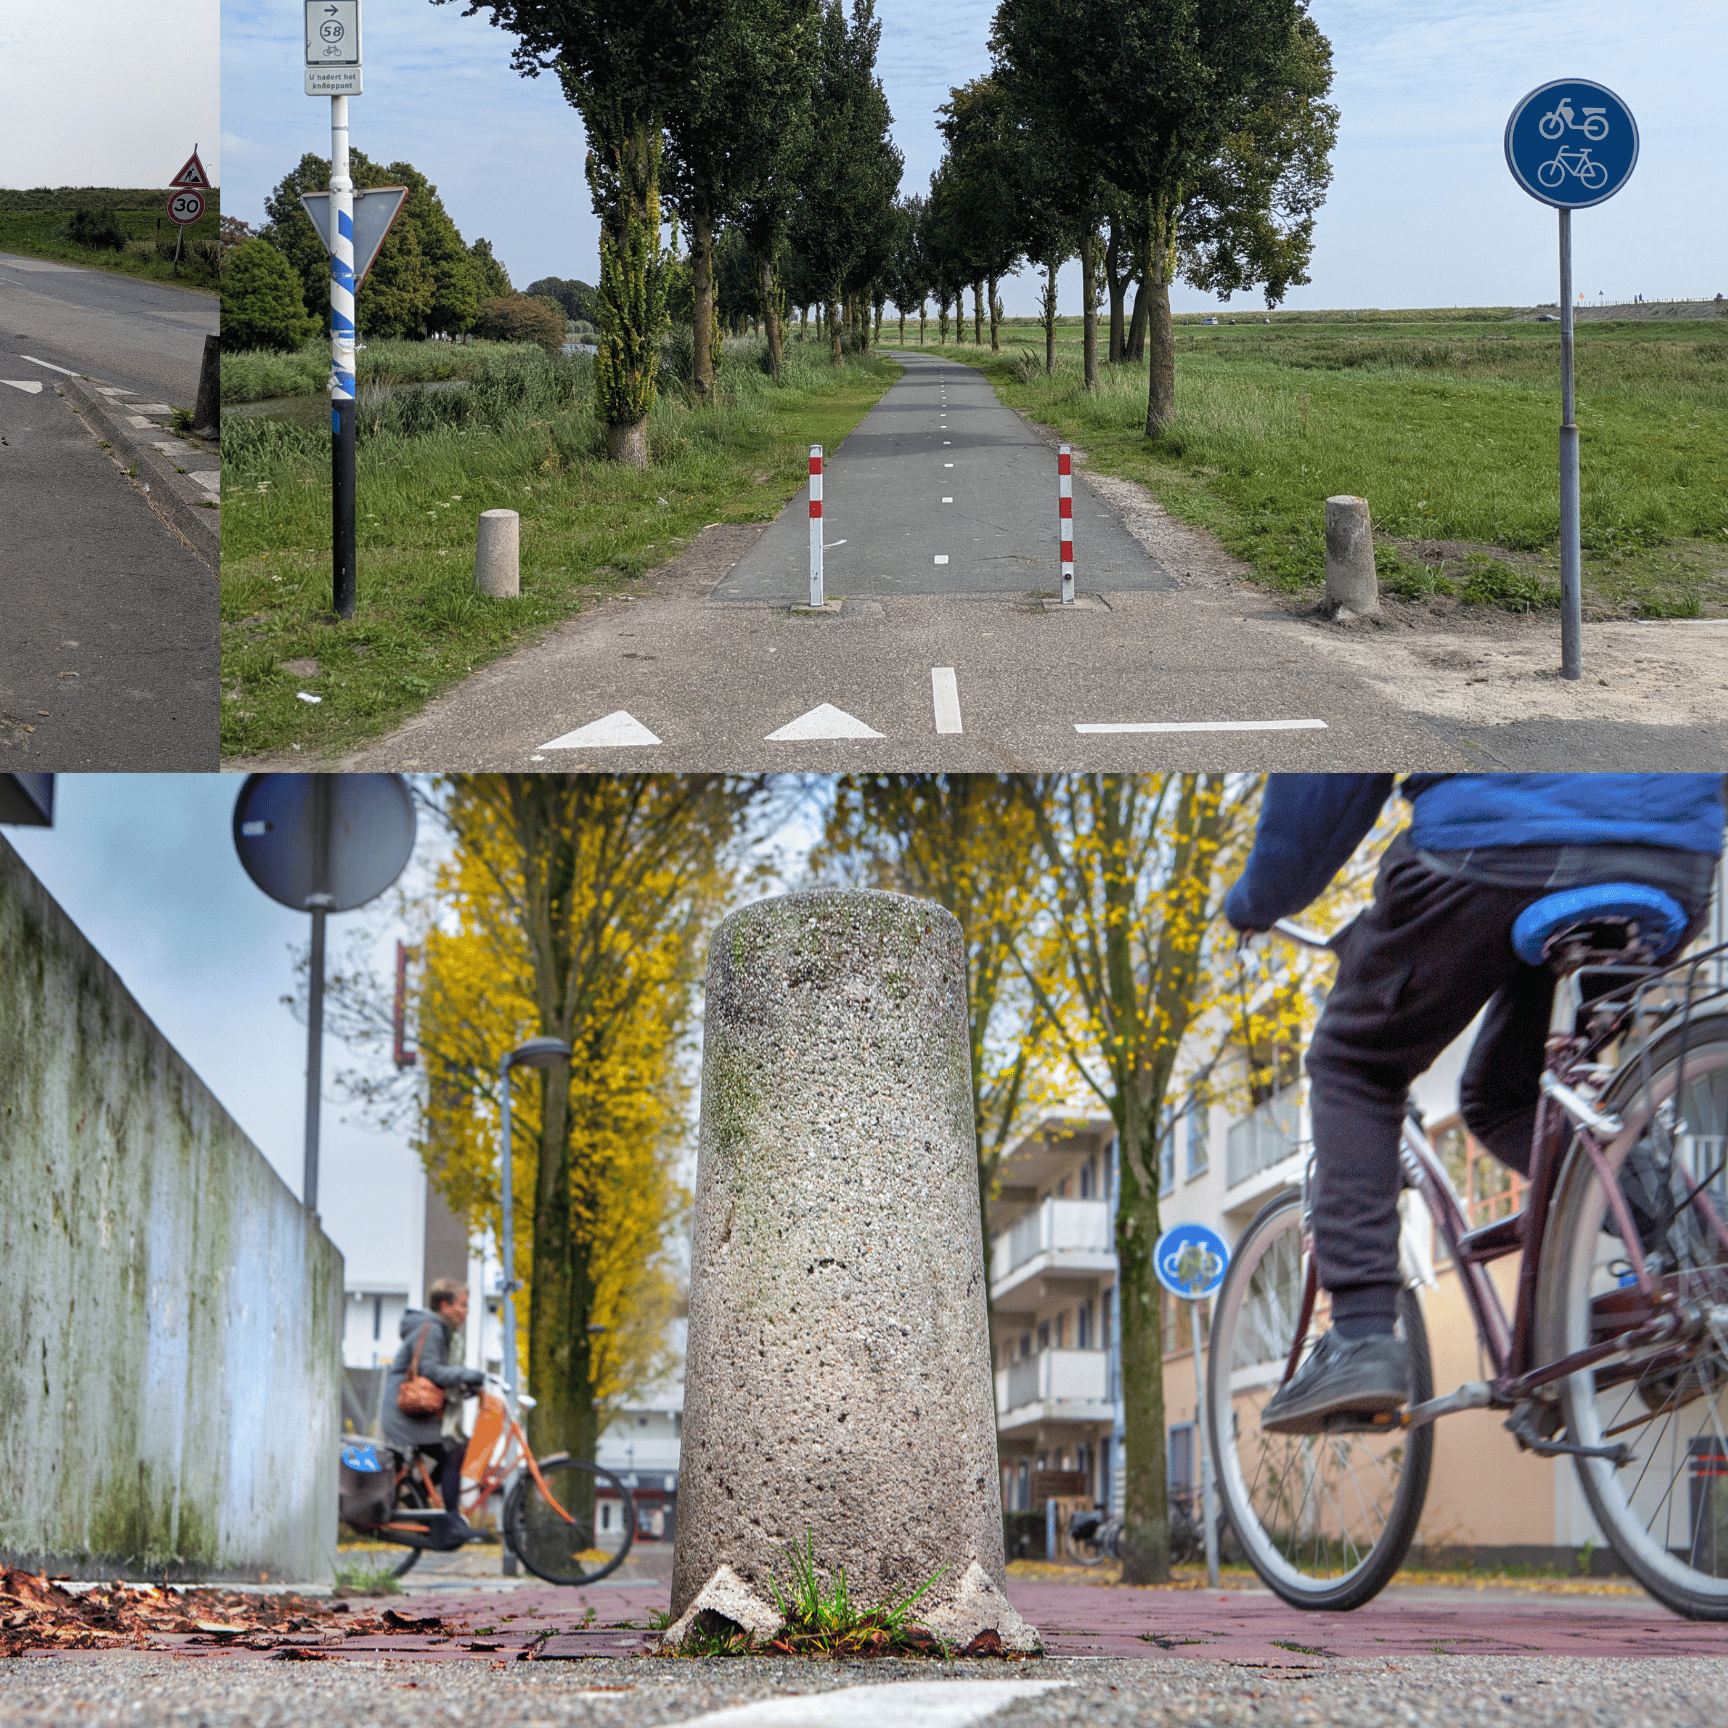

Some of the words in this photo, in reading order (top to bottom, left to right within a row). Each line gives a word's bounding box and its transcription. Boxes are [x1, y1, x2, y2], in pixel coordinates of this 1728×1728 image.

[323, 26, 342, 37] 58
[309, 73, 315, 81] U
[312, 82, 353, 90] knooppunt
[173, 198, 199, 213] 30
